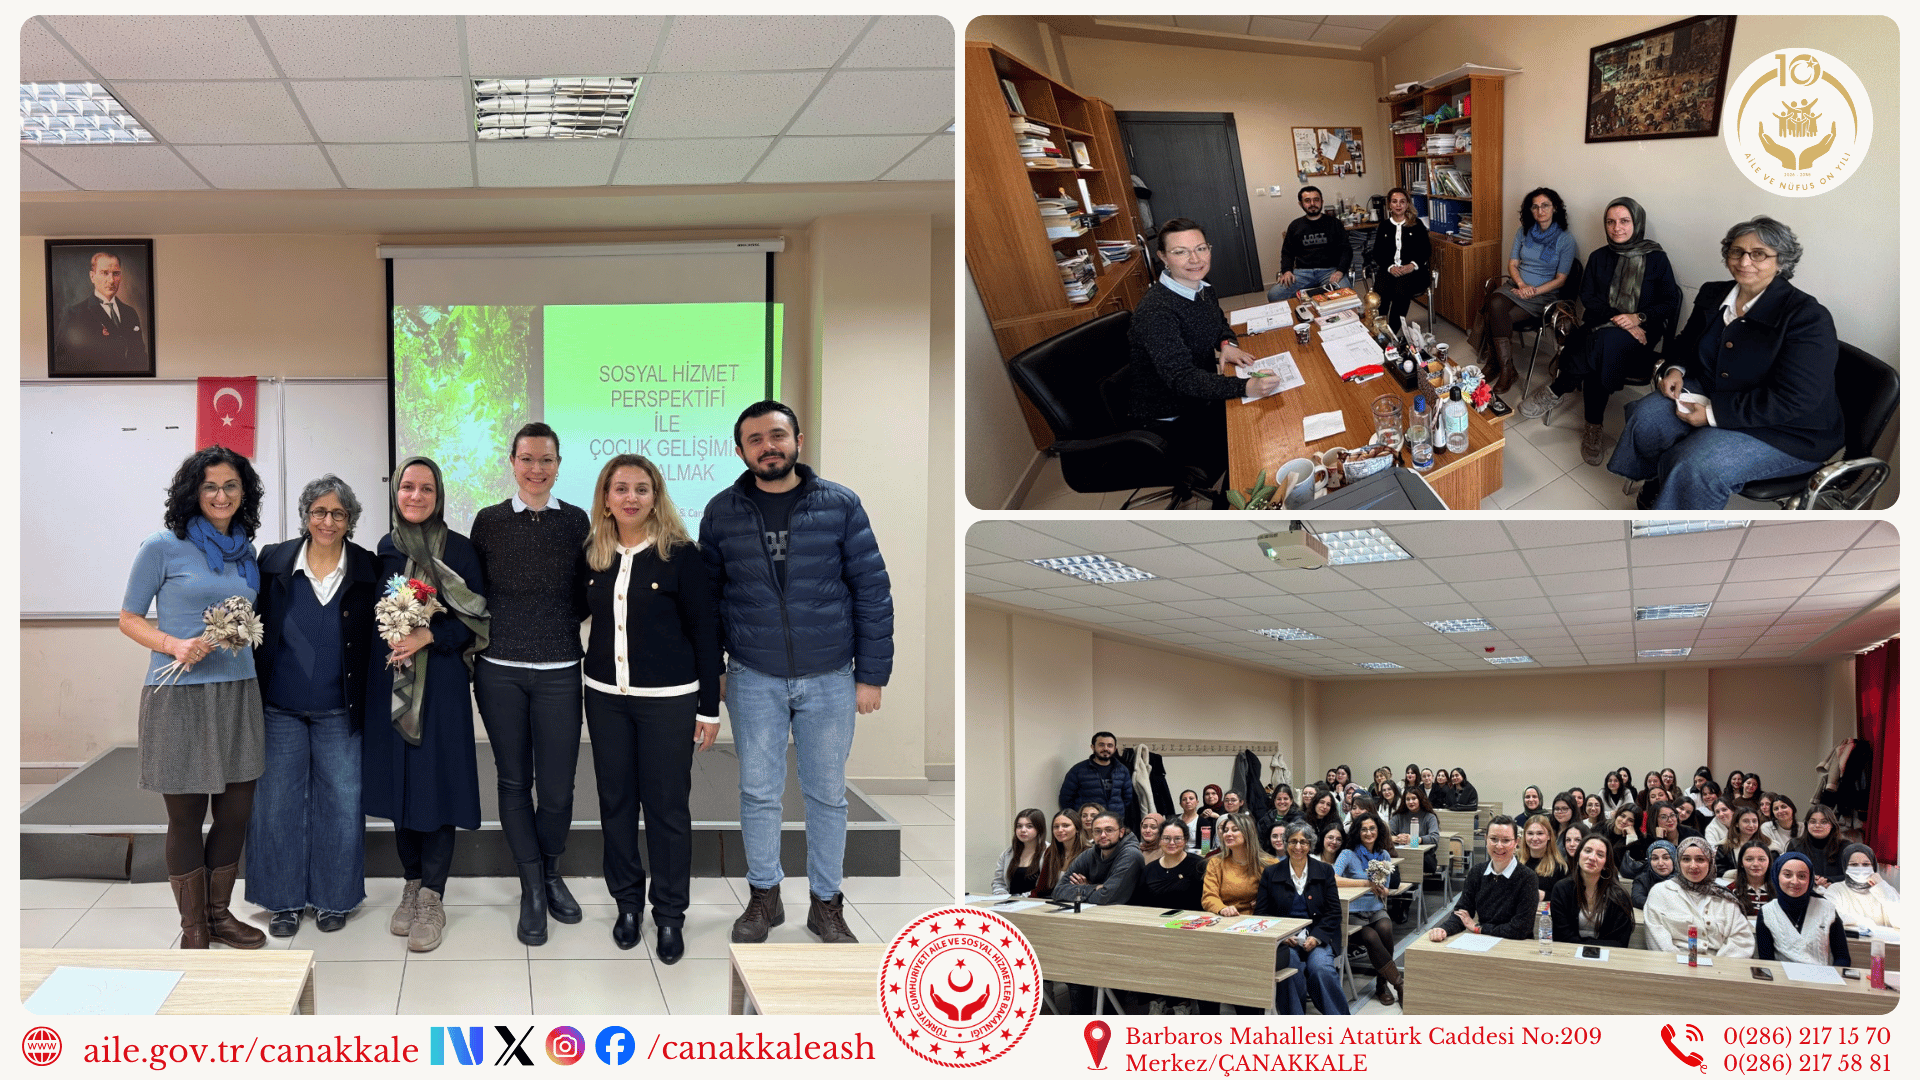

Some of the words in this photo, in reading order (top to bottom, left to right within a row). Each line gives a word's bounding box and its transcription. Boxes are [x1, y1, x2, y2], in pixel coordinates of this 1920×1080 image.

[599, 365, 668, 383] SOSYAL
[673, 361, 740, 383] HİZMET
[611, 386, 725, 408] PERSPEKTİFİ
[654, 411, 681, 433] İLE
[589, 439, 652, 460] ÇOCUK
[657, 435, 737, 461] GELİŞİMİ
